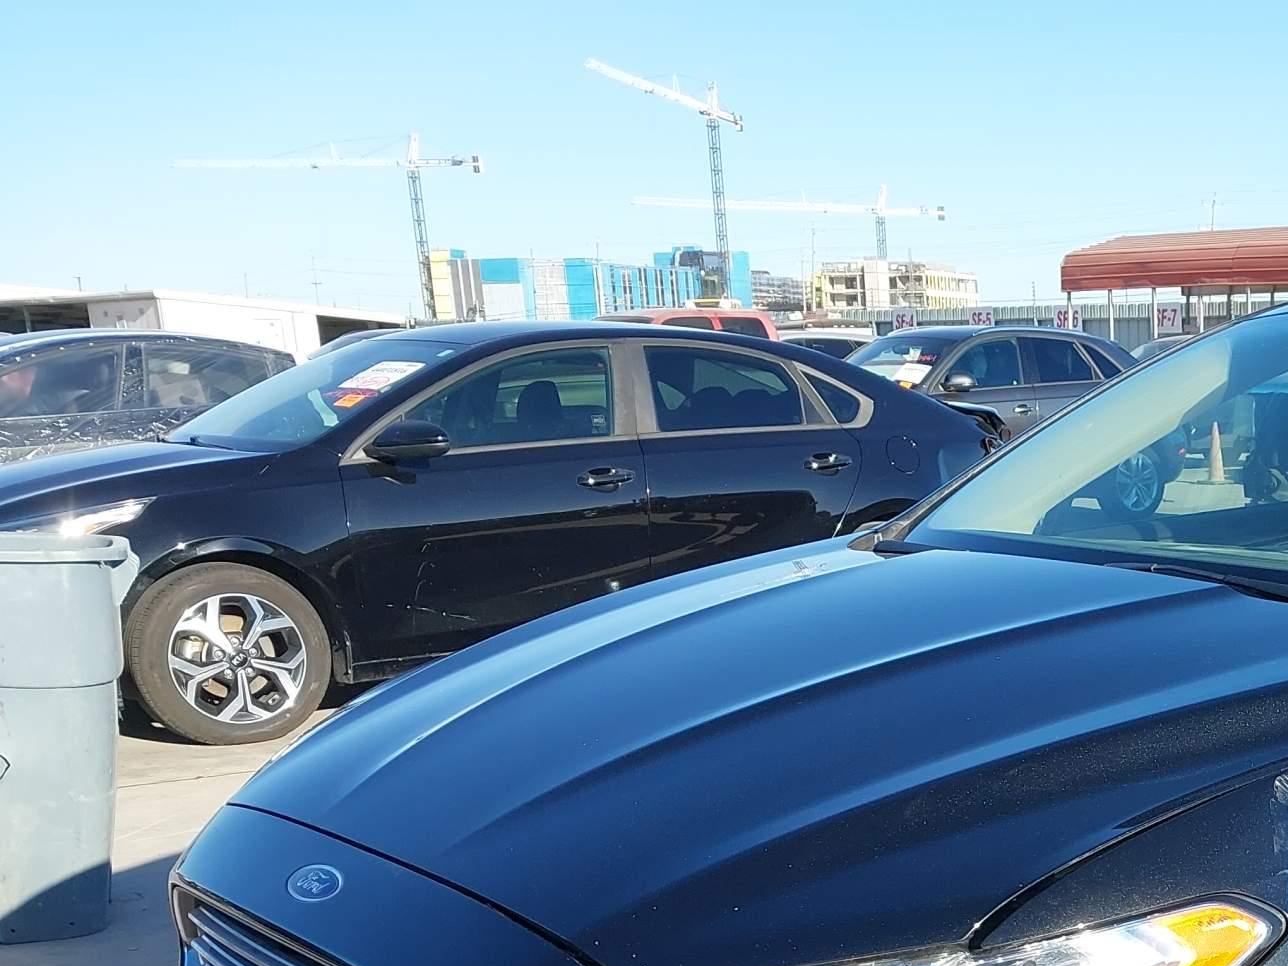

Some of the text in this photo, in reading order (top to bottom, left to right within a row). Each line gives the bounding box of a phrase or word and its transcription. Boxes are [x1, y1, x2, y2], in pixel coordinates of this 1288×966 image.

[895, 313, 914, 330] SF-4
[972, 312, 991, 326] SF-5
[1056, 310, 1079, 328] SF6
[231, 653, 246, 665] KIA
[296, 870, 331, 894] Ford
